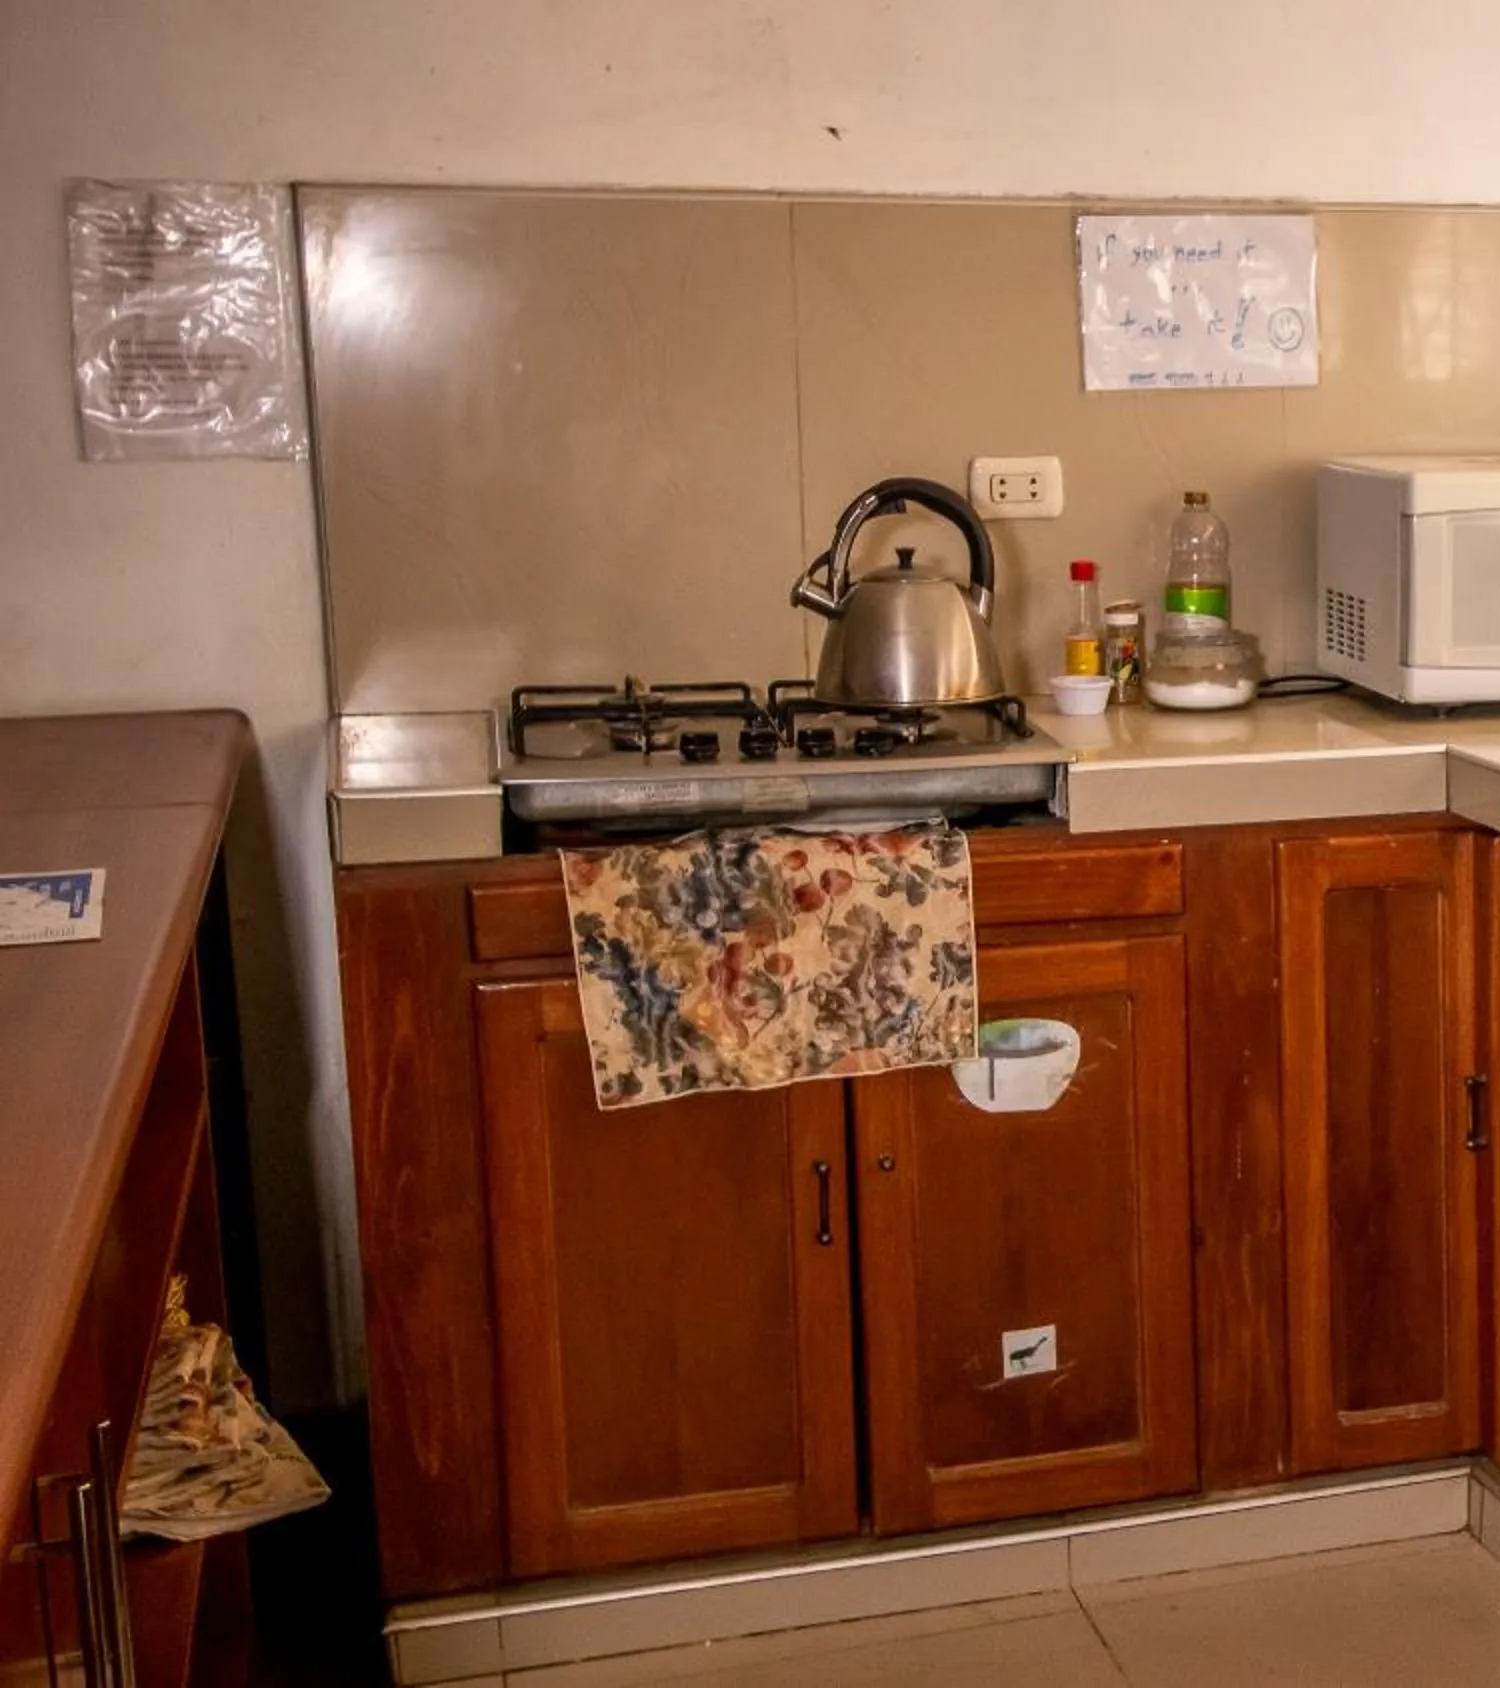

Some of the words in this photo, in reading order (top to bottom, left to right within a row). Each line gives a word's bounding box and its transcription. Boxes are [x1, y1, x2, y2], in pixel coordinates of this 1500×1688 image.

[1131, 245, 1162, 266] you
[1173, 240, 1221, 262] need
[1236, 240, 1256, 261] it
[1119, 310, 1181, 337] take
